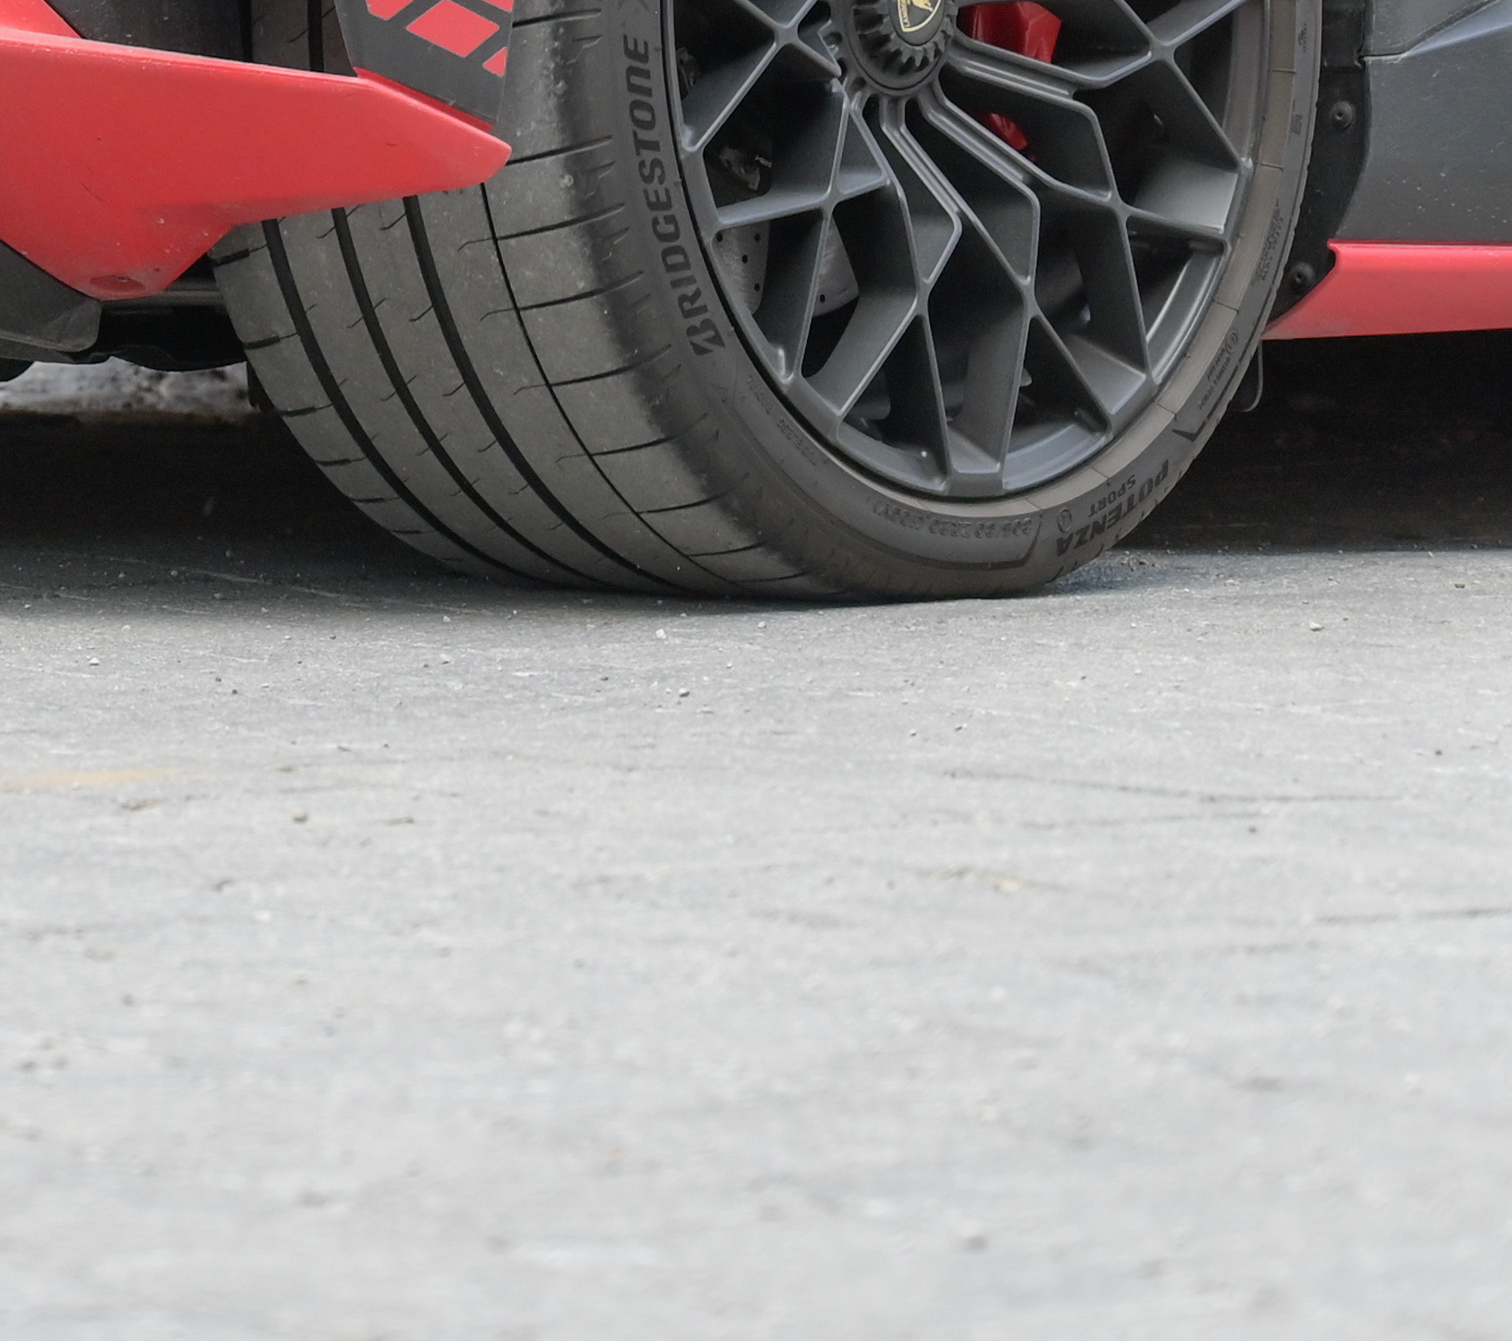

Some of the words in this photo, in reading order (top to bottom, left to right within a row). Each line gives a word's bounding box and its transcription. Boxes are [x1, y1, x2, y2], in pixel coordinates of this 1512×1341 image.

[622, 33, 727, 357] BRIDGESTONE
[1056, 458, 1169, 557] POTENZA
[1087, 473, 1137, 518] SPORT
